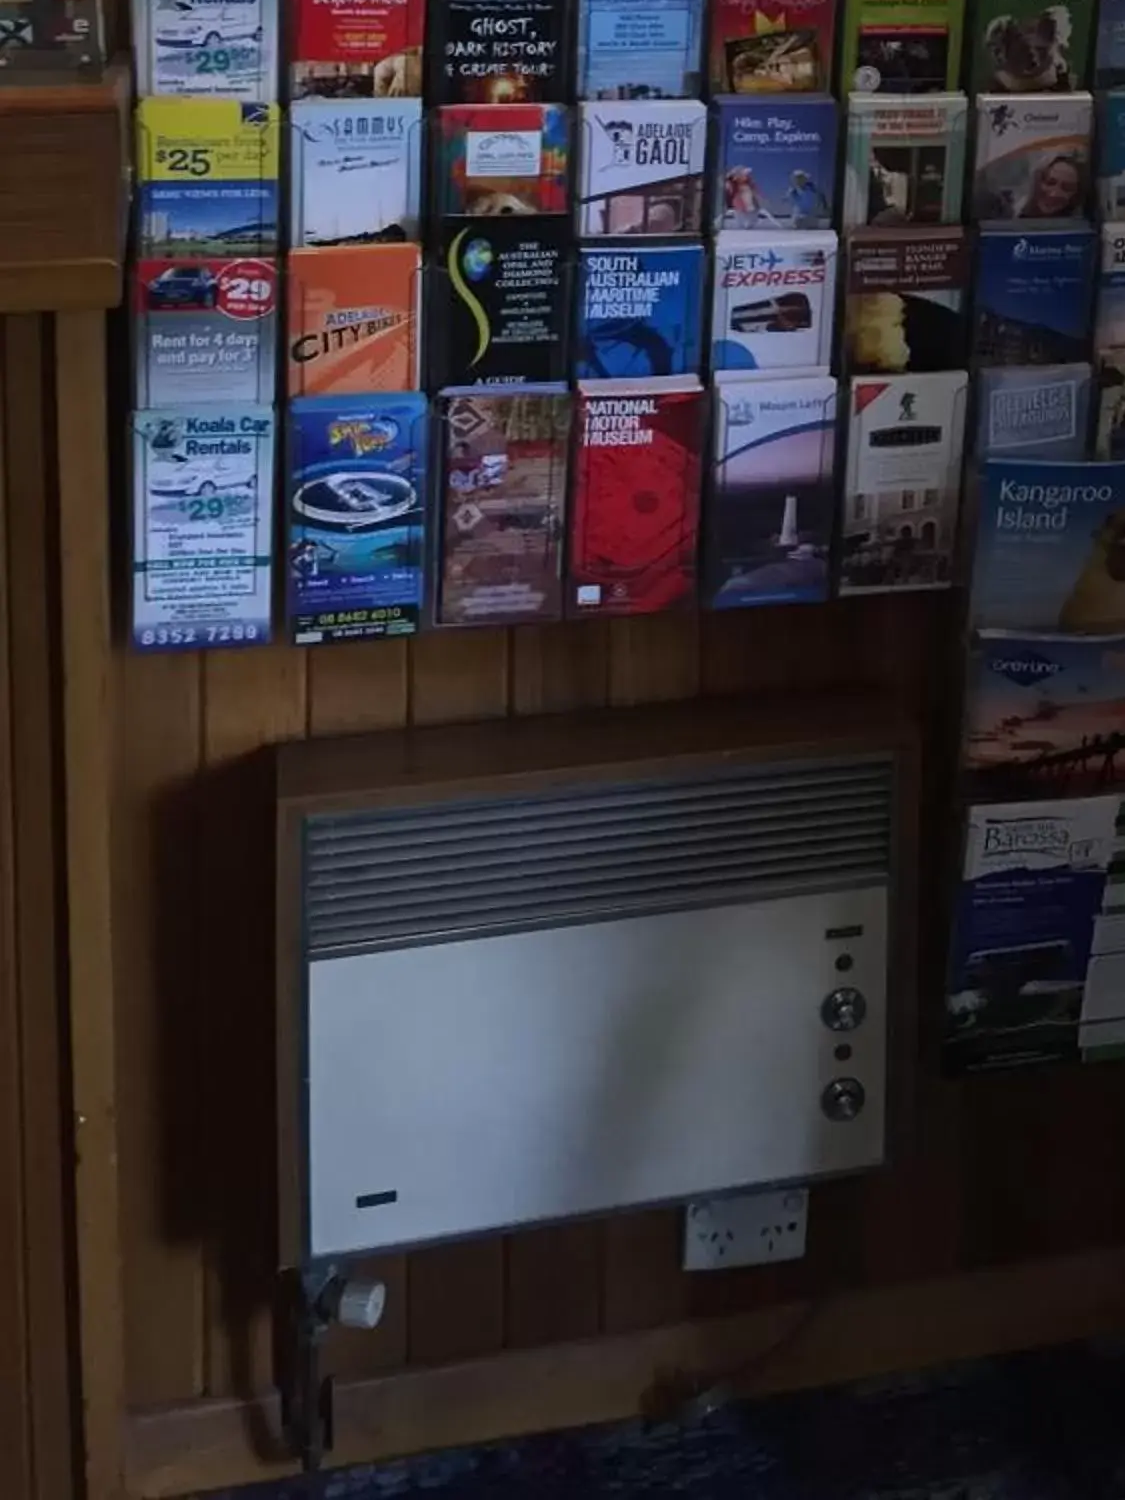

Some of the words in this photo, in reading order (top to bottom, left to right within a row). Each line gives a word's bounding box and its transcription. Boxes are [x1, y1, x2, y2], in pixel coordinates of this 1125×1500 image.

[470, 16, 538, 39] GHOST,
[445, 41, 486, 57] DARK
[492, 40, 557, 57] HISTORY
[459, 62, 507, 77] CRIME
[635, 122, 693, 138] ADELAIDE
[634, 138, 692, 166] GAOL
[155, 148, 211, 177] $25
[587, 256, 638, 271] SOUTH
[723, 253, 759, 271] JET
[586, 271, 680, 287] AUSTRALIAN
[720, 268, 827, 289] EXPRESS
[220, 276, 272, 302] $29
[585, 287, 661, 303] MARITIME
[585, 302, 654, 320] MUSEUM
[151, 333, 187, 348] Rent
[189, 332, 210, 347] for
[212, 333, 223, 347] 4
[292, 322, 363, 364] CITY
[156, 350, 184, 365] and
[186, 351, 216, 367] pay
[217, 349, 240, 364] for
[585, 399, 658, 415] NATIONAL
[186, 416, 235, 434] Koala
[239, 416, 271, 433] Car
[584, 415, 640, 431] MOTOR
[185, 439, 252, 456] Rentals
[584, 430, 653, 447] MUSEUM
[1000, 479, 1112, 508] Kangaroo
[997, 506, 1067, 530] Island
[141, 626, 197, 645] 8352
[983, 825, 1070, 850] Barossa
